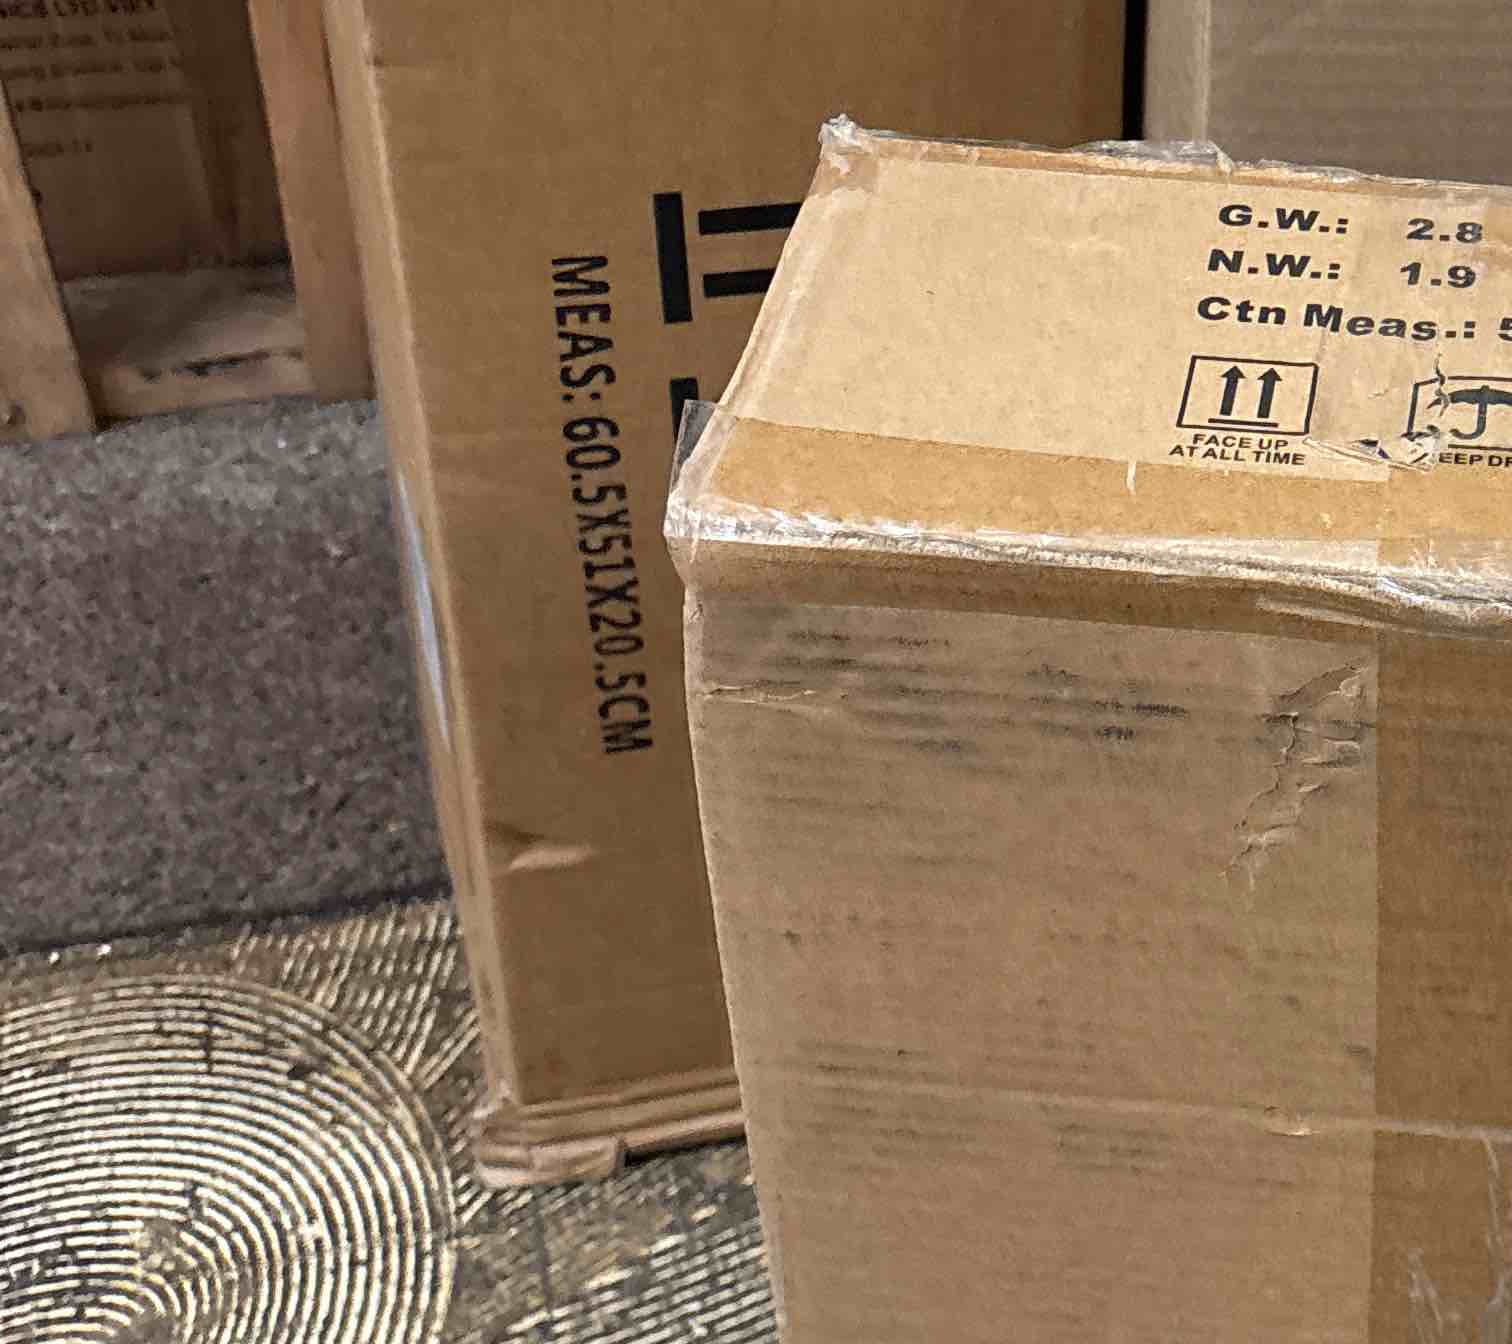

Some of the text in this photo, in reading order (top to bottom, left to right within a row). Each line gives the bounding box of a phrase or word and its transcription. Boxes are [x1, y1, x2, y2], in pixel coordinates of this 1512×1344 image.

[1219, 204, 1349, 234] G.W.:
[1407, 218, 1483, 244] 2.8
[1207, 249, 1341, 280] N.W.:
[1400, 262, 1477, 289] 1.9
[551, 254, 617, 404] MEAS:
[1197, 296, 1286, 325] Ctn
[1303, 303, 1476, 342] Meas.:
[1169, 444, 1305, 466] AT ALL TIME
[1193, 433, 1289, 451] FACE UP
[1438, 452, 1485, 466] EEP
